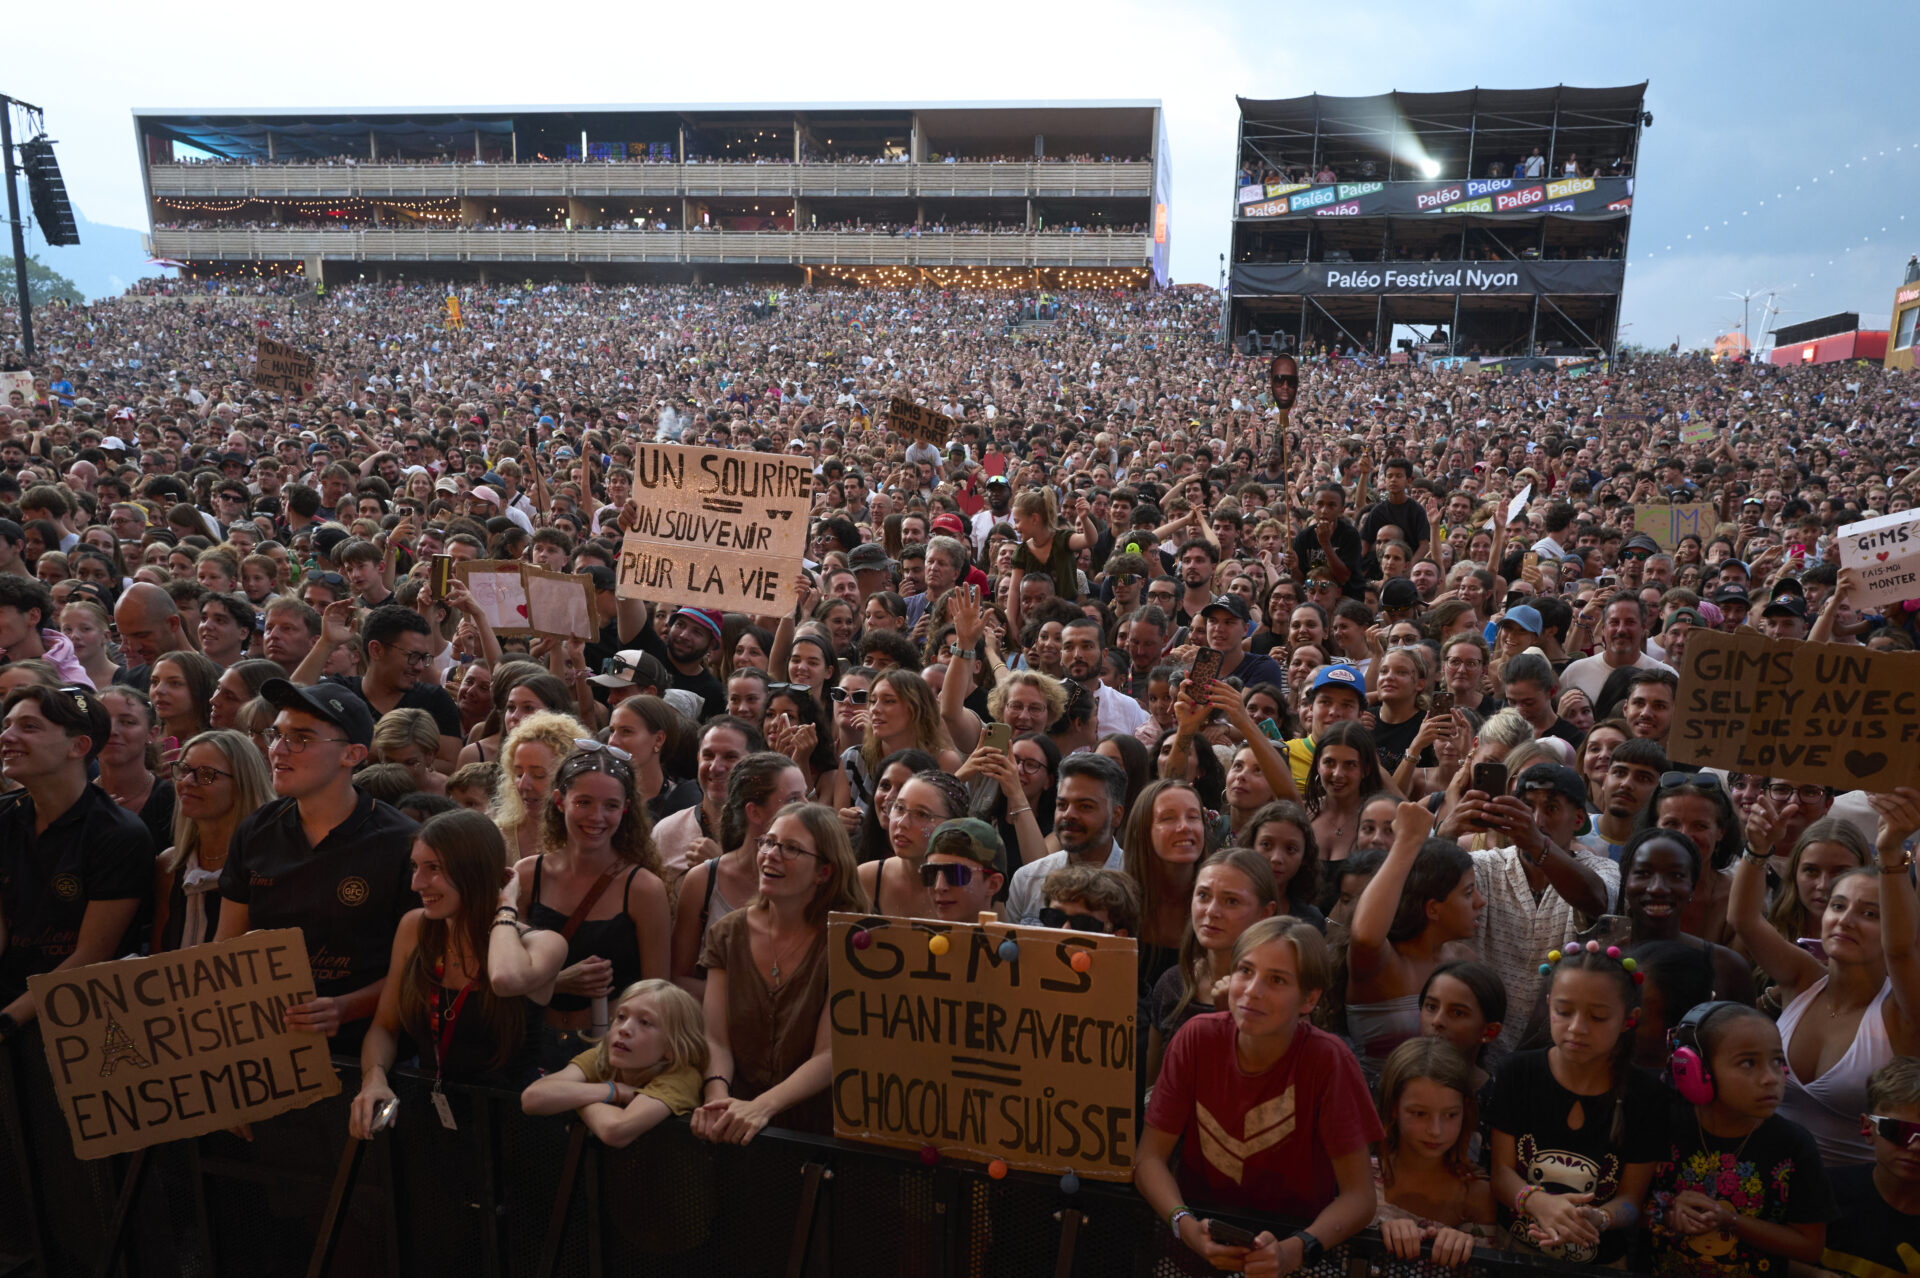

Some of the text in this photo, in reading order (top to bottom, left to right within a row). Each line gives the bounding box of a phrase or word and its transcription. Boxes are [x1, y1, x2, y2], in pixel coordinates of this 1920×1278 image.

[1292, 190, 1334, 209] Paléo
[1417, 189, 1460, 208] Paléo
[1497, 190, 1542, 209] Paléo
[1327, 269, 1519, 291] Paléo Festival Nyon
[256, 373, 280, 389] AVEC
[891, 398, 922, 420] GIMS
[890, 415, 945, 445] TROP FORT
[639, 446, 814, 499] UN SOURIRE
[630, 505, 772, 550] UN SOUVENIR
[619, 551, 779, 602] POUR LA VIE
[1869, 572, 1917, 591] MONTER
[1694, 648, 1872, 685] GIMS UN
[1688, 688, 1917, 716] SELFY AVEC
[1683, 718, 1745, 740] STP
[1752, 719, 1791, 738] JE
[1803, 718, 1888, 740] SUIS
[1736, 743, 1832, 768] LOVE
[344, 887, 362, 896] GFC
[844, 916, 1098, 994] GIMS
[44, 945, 293, 1028] ON CHANTE
[829, 988, 1008, 1055] CHANTER
[1009, 1007, 1097, 1065] AVEC
[71, 1044, 323, 1142] ENSEMBLE
[833, 1067, 1132, 1168] CHOCOLAT SUISSE
